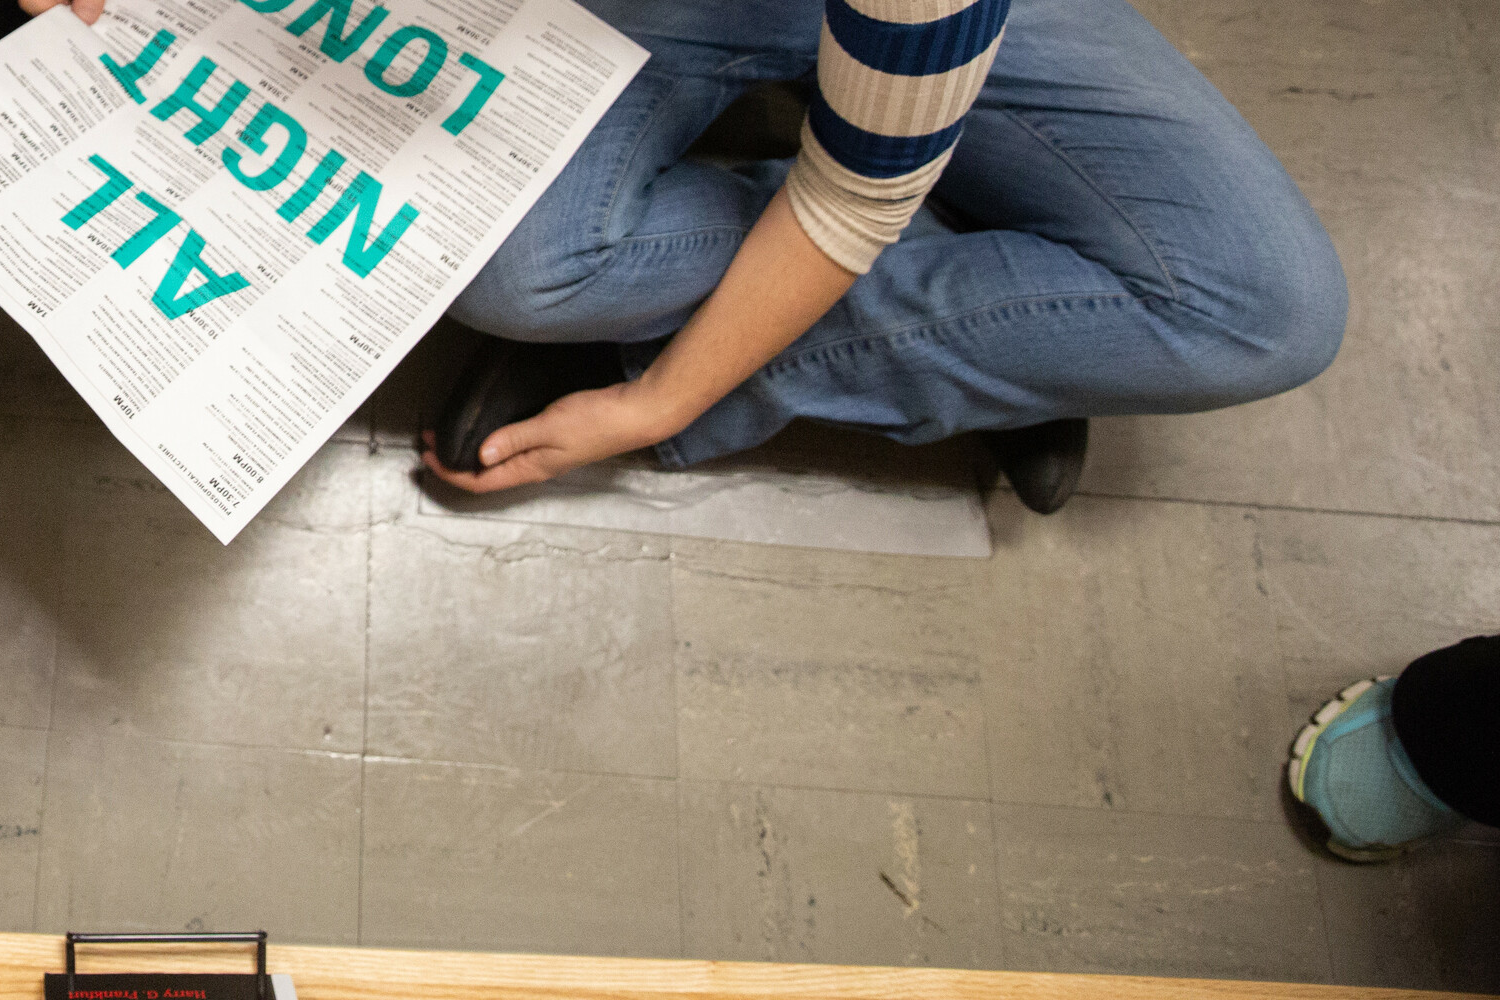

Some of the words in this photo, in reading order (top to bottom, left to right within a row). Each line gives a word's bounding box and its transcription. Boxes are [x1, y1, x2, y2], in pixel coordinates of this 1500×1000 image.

[9, 151, 32, 172] 11PM
[99, 30, 419, 279] NIGHT
[60, 154, 251, 321] ALL
[439, 253, 460, 271] 9PM
[26, 298, 47, 319] 1AM
[184, 306, 219, 340] 10:30PM
[348, 332, 381, 361] 8:30PM
[111, 394, 137, 419] 10PM
[157, 442, 187, 472] LECTURES
[232, 452, 264, 483] 8:00PM
[186, 470, 232, 515] PHILOSOPHICAL
[208, 476, 240, 507] 7:30PM
[164, 988, 206, 1000] Harry
